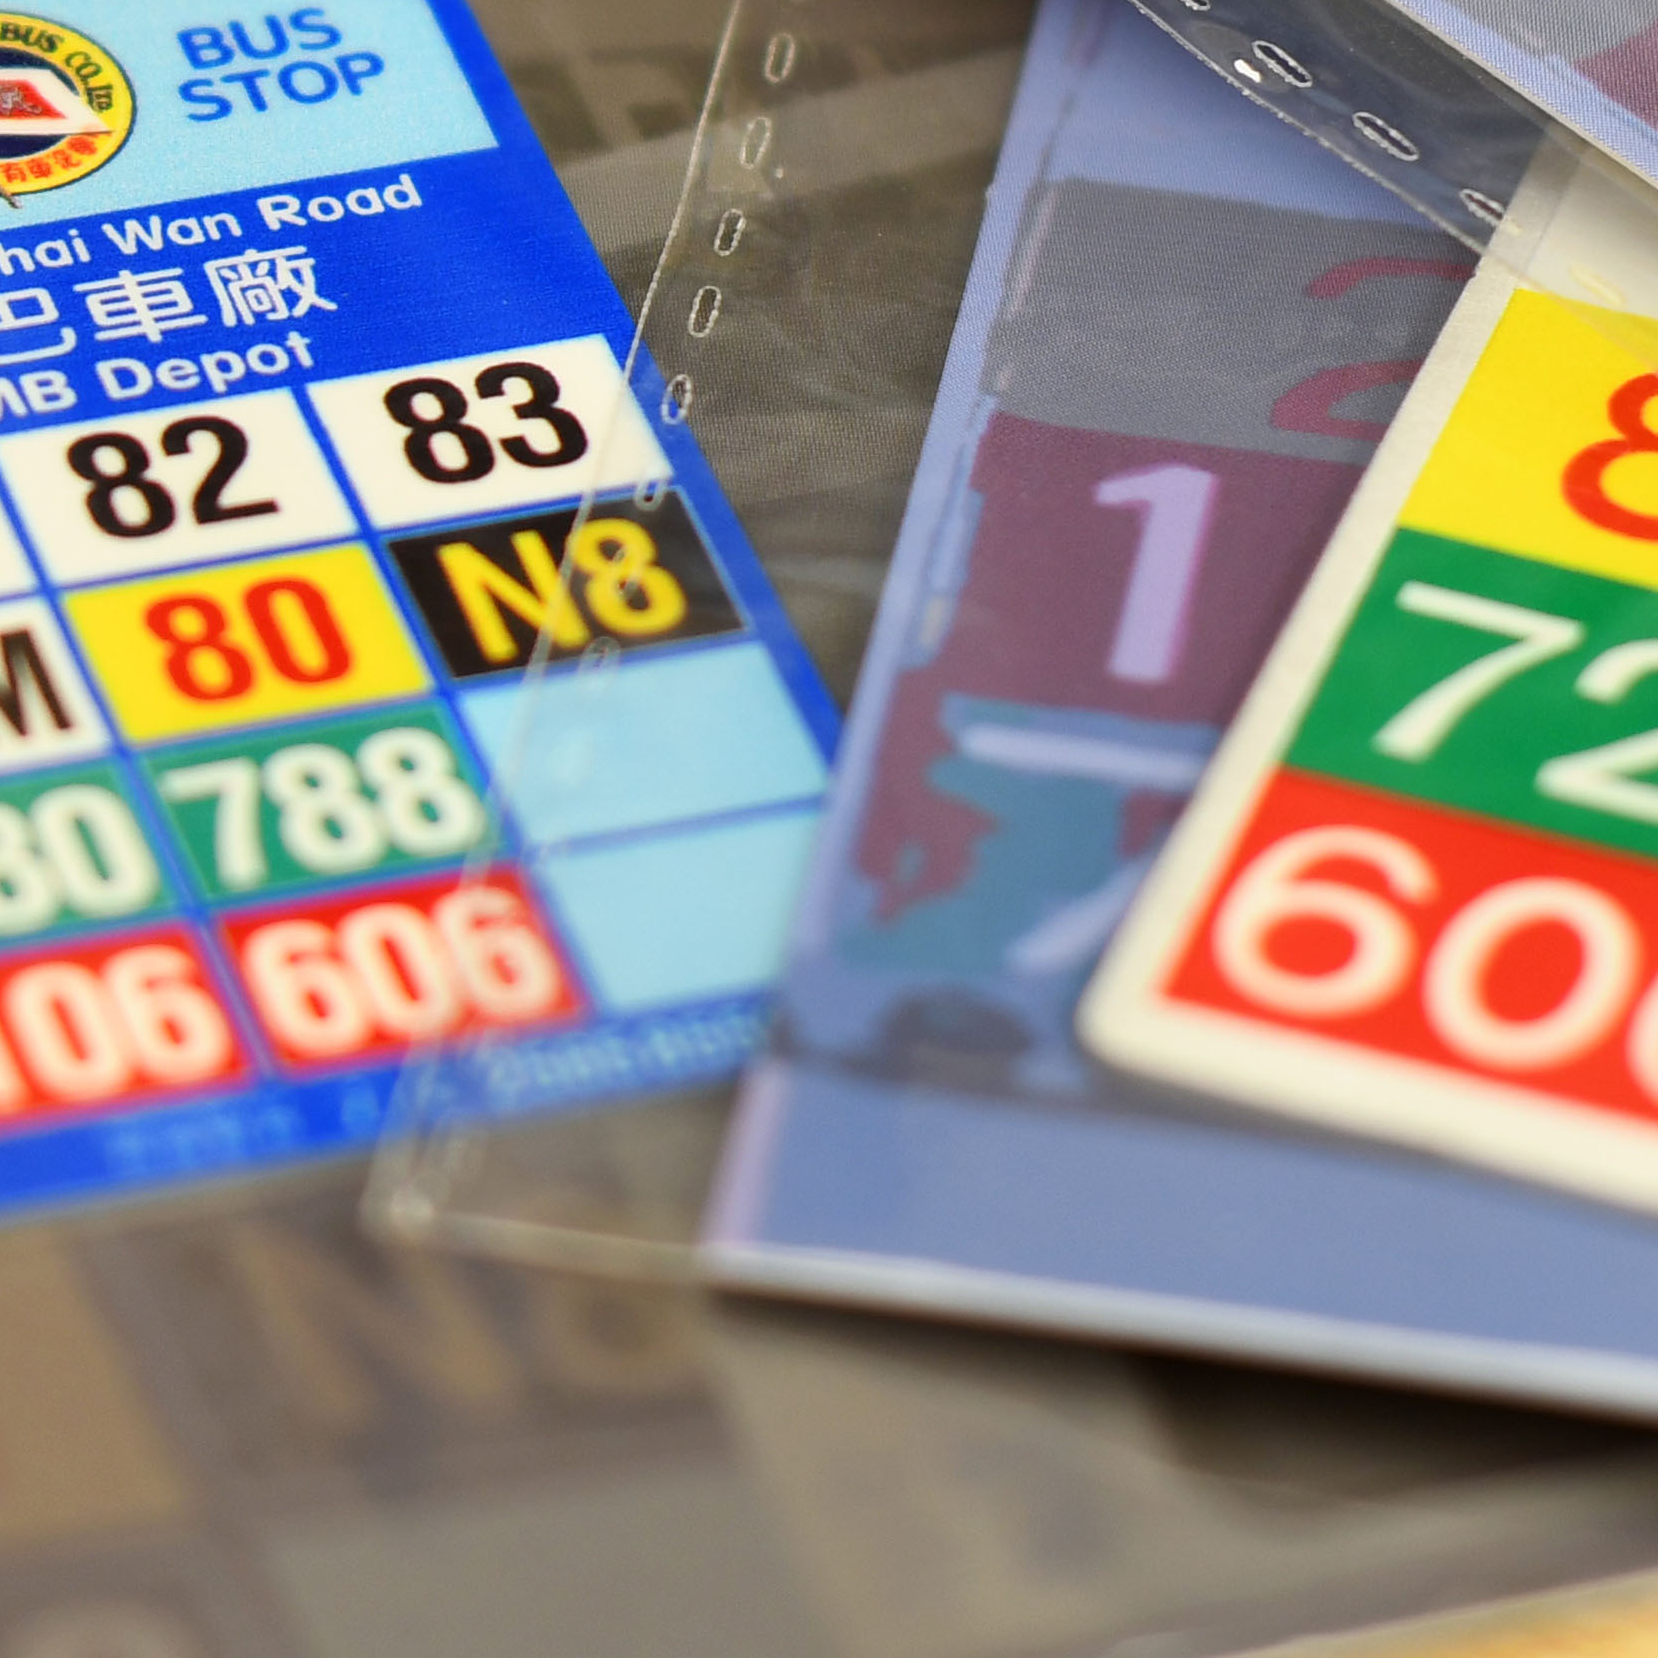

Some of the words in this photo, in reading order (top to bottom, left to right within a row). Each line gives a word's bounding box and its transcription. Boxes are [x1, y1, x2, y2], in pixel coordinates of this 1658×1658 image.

[177, 7, 343, 73] BUS
[177, 53, 386, 124] STOP
[112, 208, 242, 256] Wan
[256, 176, 424, 232] Road
[64, 414, 280, 539] 82
[382, 360, 589, 486] 83
[102, 333, 315, 404] Depot
[141, 575, 354, 706] 80
[436, 516, 688, 663] N8
[1094, 462, 1219, 684] 1
[155, 724, 492, 893] 788
[238, 882, 567, 1060] 606
[1210, 824, 1658, 1117] 60
